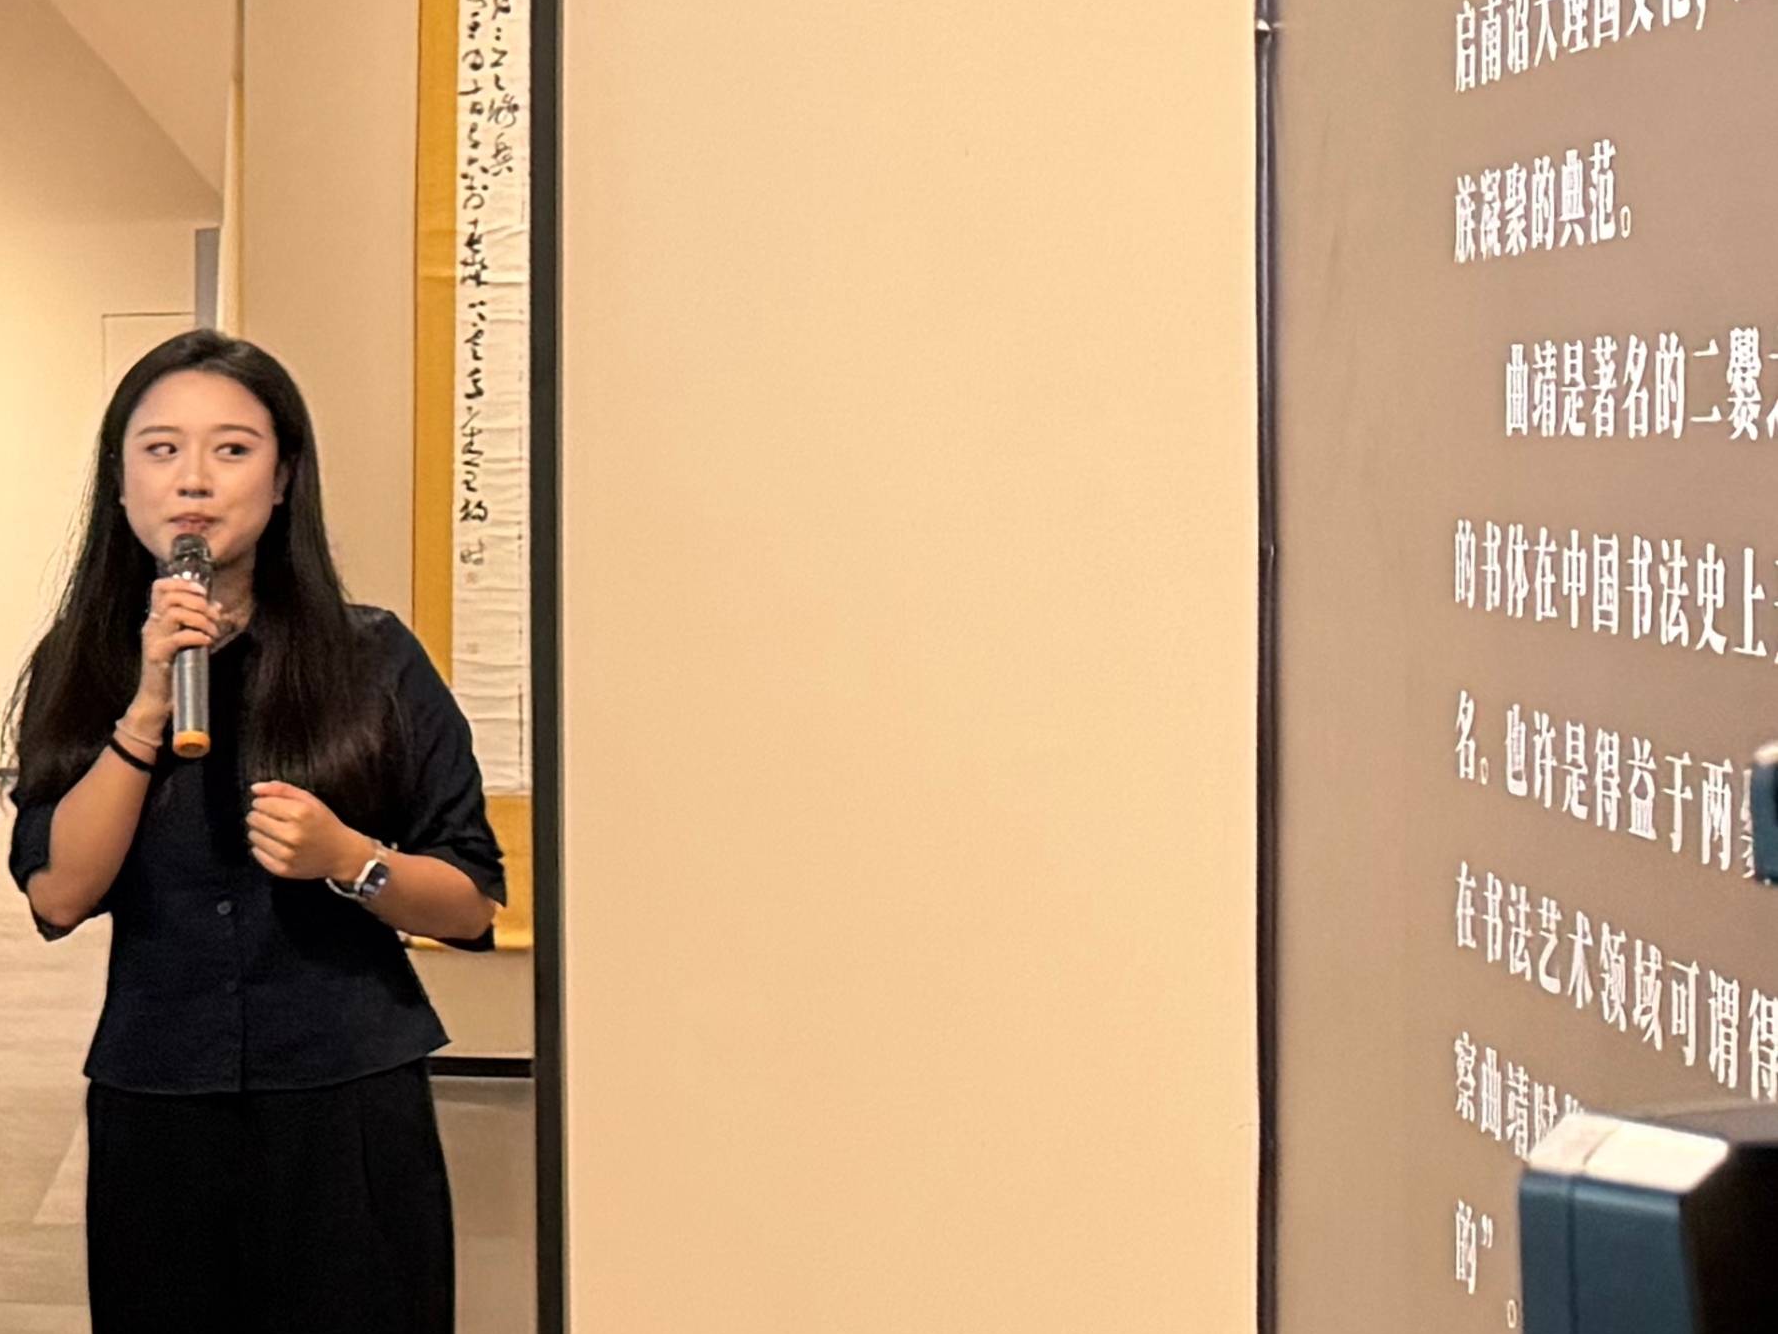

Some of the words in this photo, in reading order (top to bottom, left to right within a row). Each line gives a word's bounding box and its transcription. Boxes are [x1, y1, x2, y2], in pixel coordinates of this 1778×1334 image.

[1453, 138, 1631, 264] 族凝聚的典范。
[1454, 520, 1778, 663] 的书体在中国书法史上
